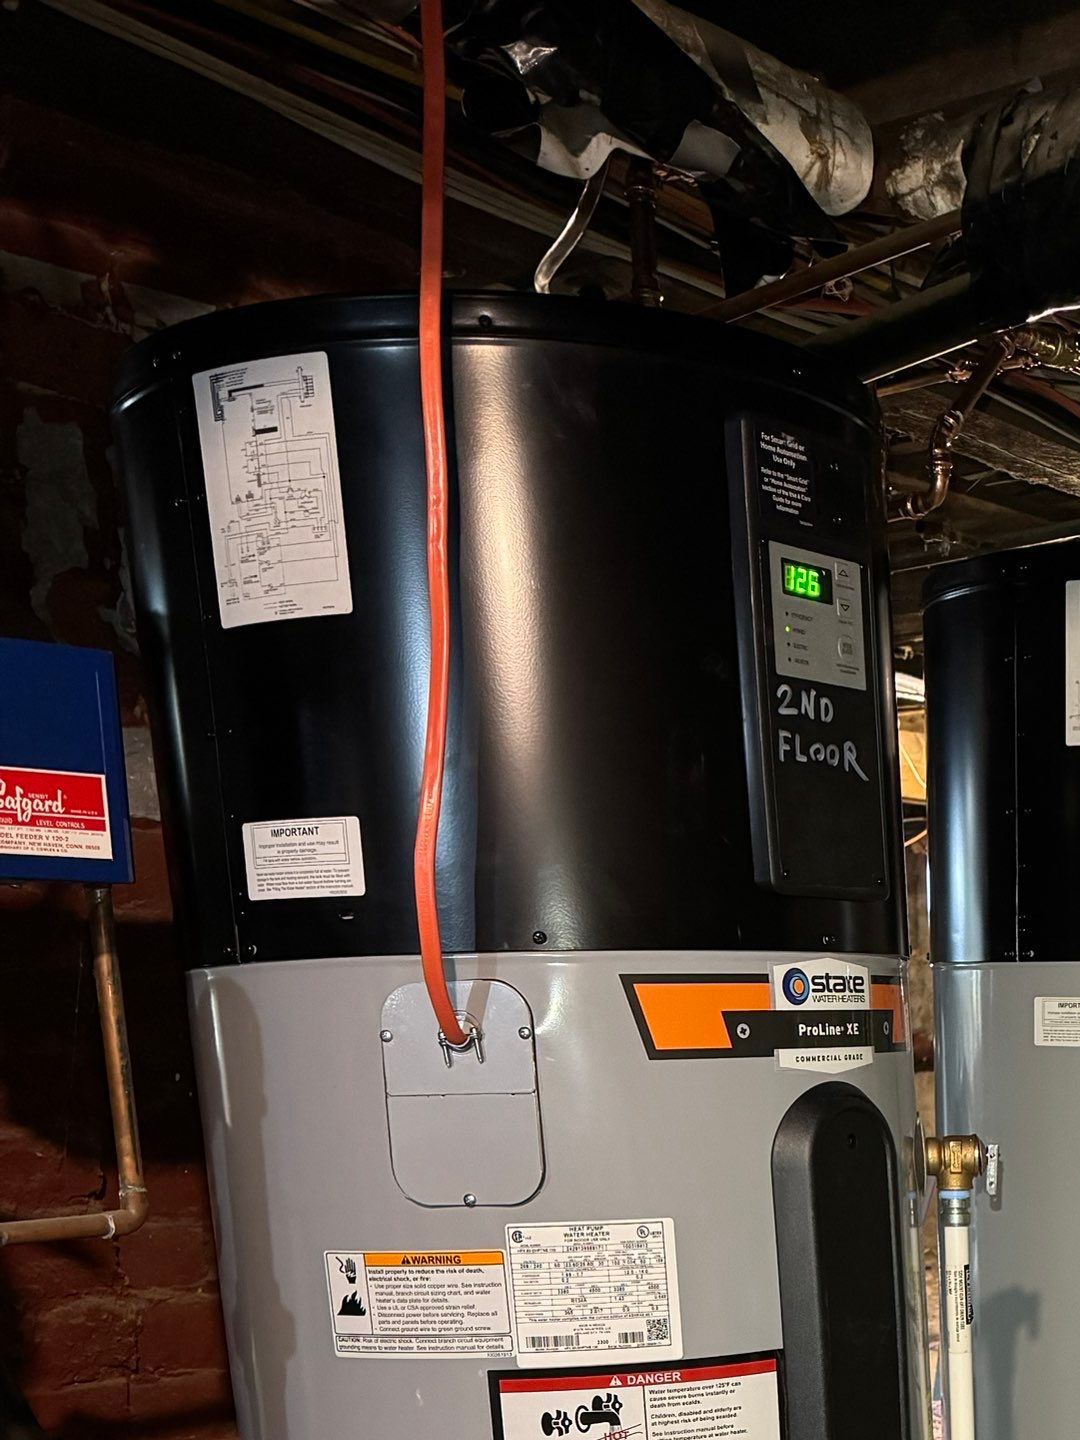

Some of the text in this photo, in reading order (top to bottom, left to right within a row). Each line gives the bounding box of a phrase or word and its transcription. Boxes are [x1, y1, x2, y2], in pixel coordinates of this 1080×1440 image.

[786, 565, 820, 597] 126
[776, 684, 834, 723] 2ND
[778, 729, 870, 781] FLOOR
[36, 819, 54, 827] LEVEL
[56, 820, 86, 829] CONTROLS
[271, 826, 319, 837] IMPORTANT
[811, 973, 865, 994] state
[812, 994, 865, 1003] WATER HEATERS
[847, 1023, 859, 1035] XE
[795, 1054, 842, 1063] COMMERCIAL
[411, 1255, 462, 1265] WARNING
[627, 1372, 681, 1385] DANGER
[667, 1386, 700, 1394] temperature
[705, 1389, 728, 1397] instantly
[651, 1412, 676, 1420] Children,
[700, 1414, 715, 1422] being
[604, 1430, 629, 1440] HOT
[665, 1428, 697, 1436] instruction
